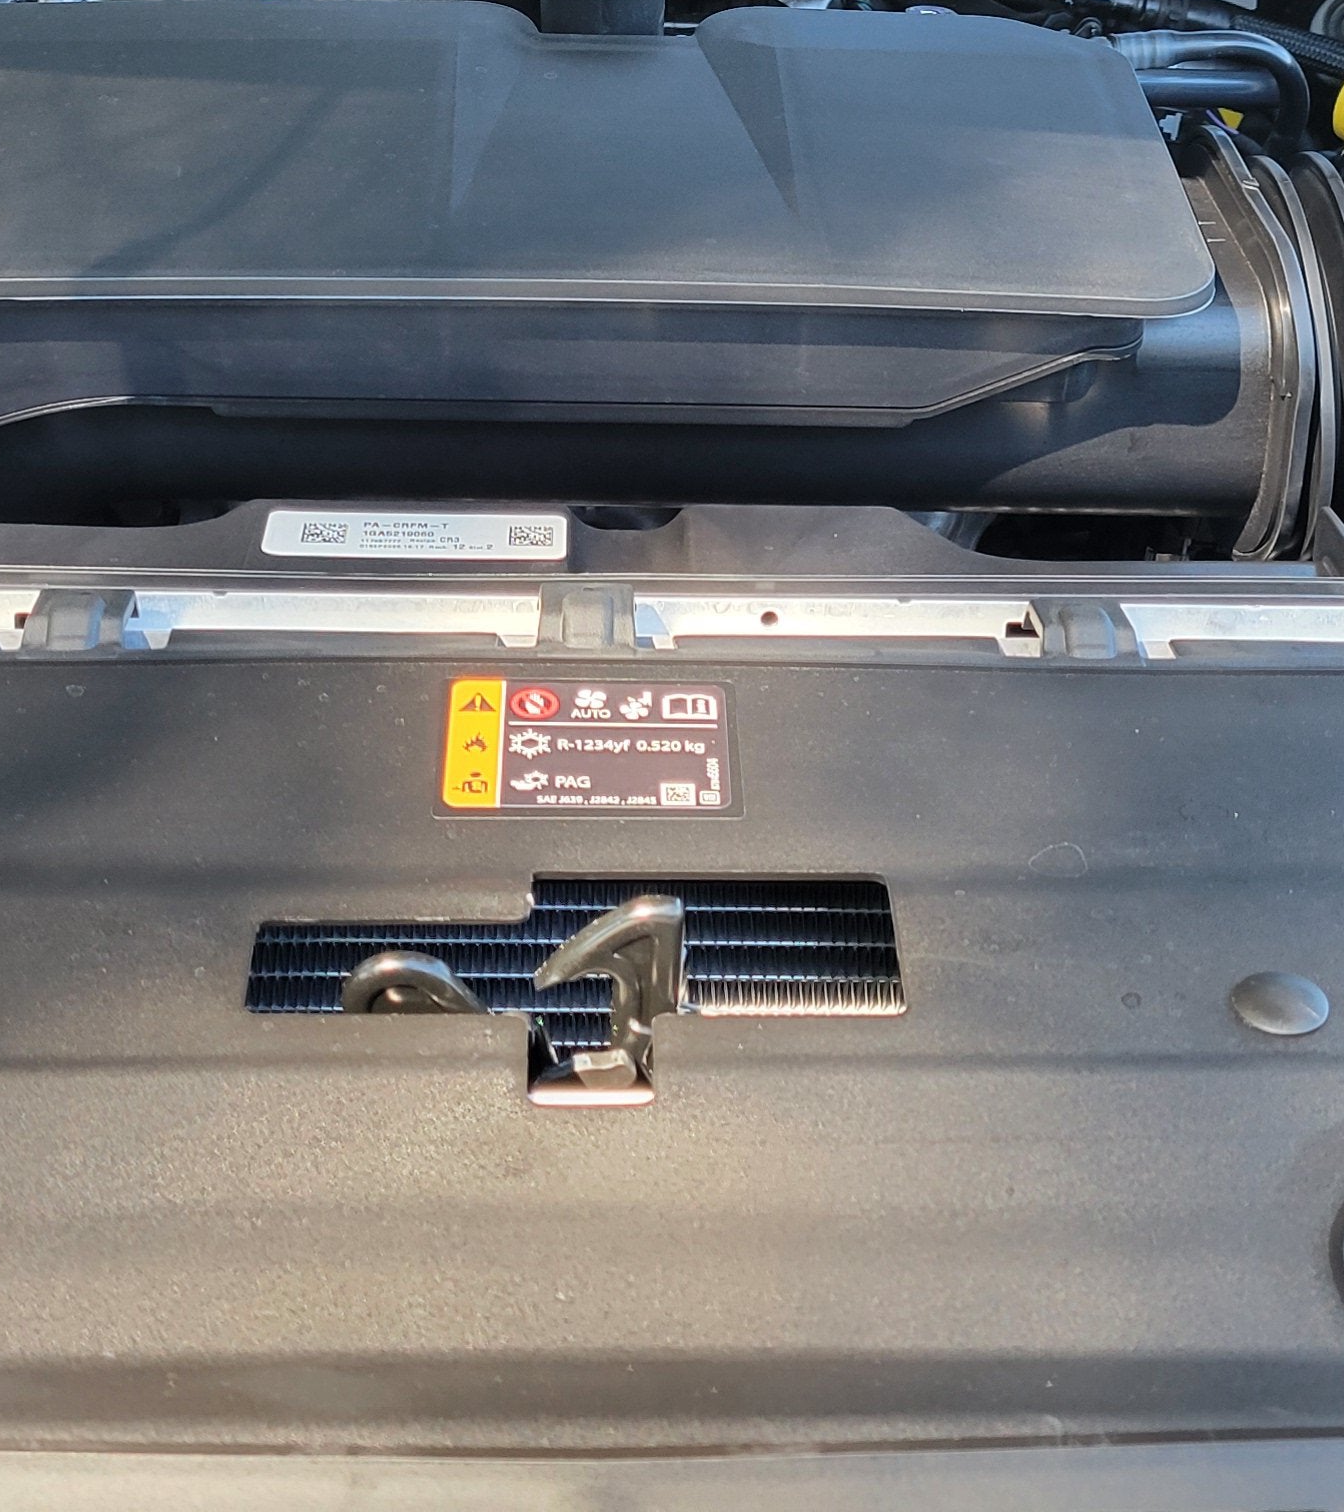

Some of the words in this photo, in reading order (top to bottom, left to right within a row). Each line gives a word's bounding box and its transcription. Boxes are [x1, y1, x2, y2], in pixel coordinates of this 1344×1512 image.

[570, 708, 611, 719] AUTO
[557, 738, 630, 753] R-1234yf
[636, 740, 681, 752] 0.520
[685, 739, 706, 754] kg
[555, 775, 591, 788] PAG
